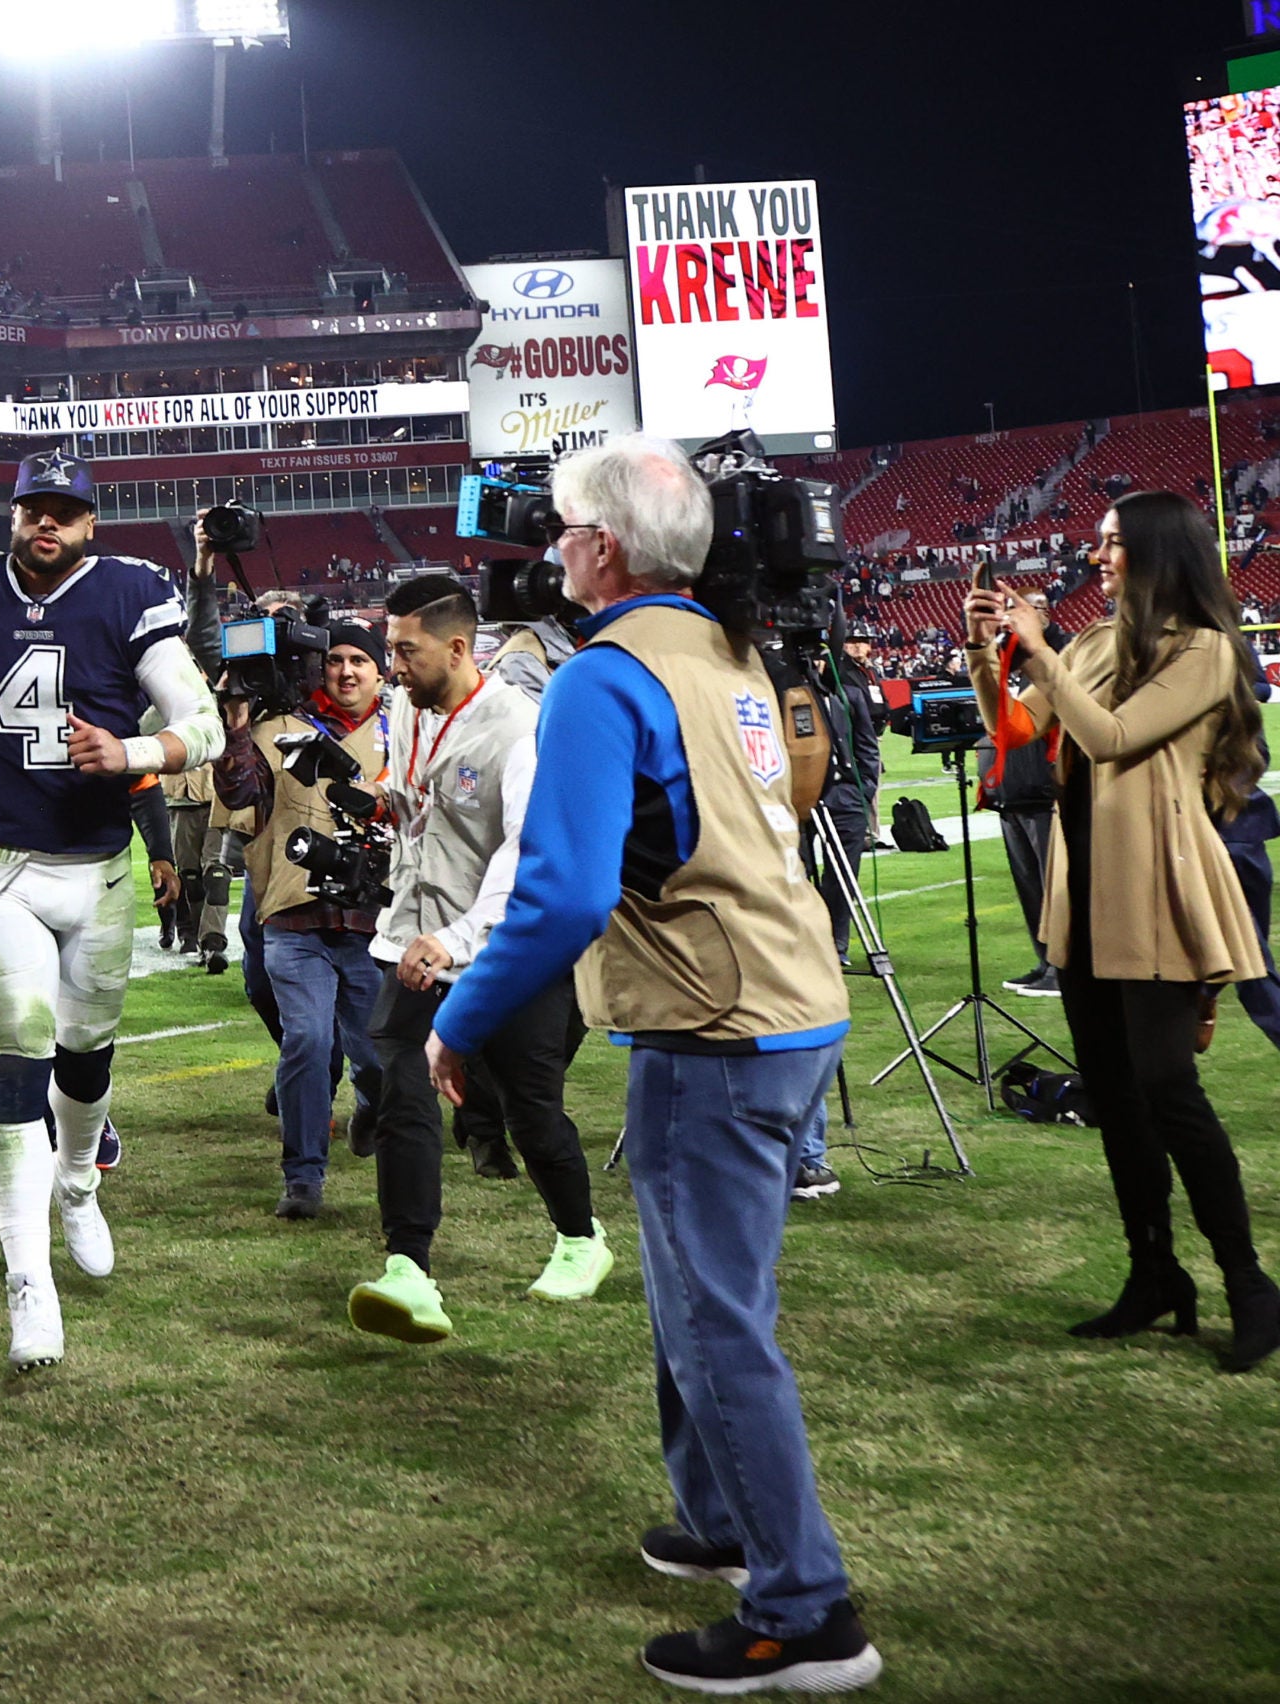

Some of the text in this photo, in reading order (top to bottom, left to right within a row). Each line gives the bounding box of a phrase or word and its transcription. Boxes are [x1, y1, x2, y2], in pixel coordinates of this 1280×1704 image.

[632, 187, 812, 241] THANK YOU
[635, 239, 819, 325] KREWE
[491, 303, 600, 322] HYUNDAI
[119, 323, 242, 344] TONY DUNGY
[510, 333, 630, 379] #GOBUCS
[13, 389, 378, 430] THANK YOU KREWE FOR ALL OF YOUR SUPPORT
[519, 392, 547, 408] IT'S
[501, 399, 609, 450] Miller
[260, 457, 286, 469] TEXT
[290, 456, 311, 467] FAN
[313, 453, 351, 466] ISSUES
[354, 453, 368, 464] TO
[744, 731, 776, 772] NFL
